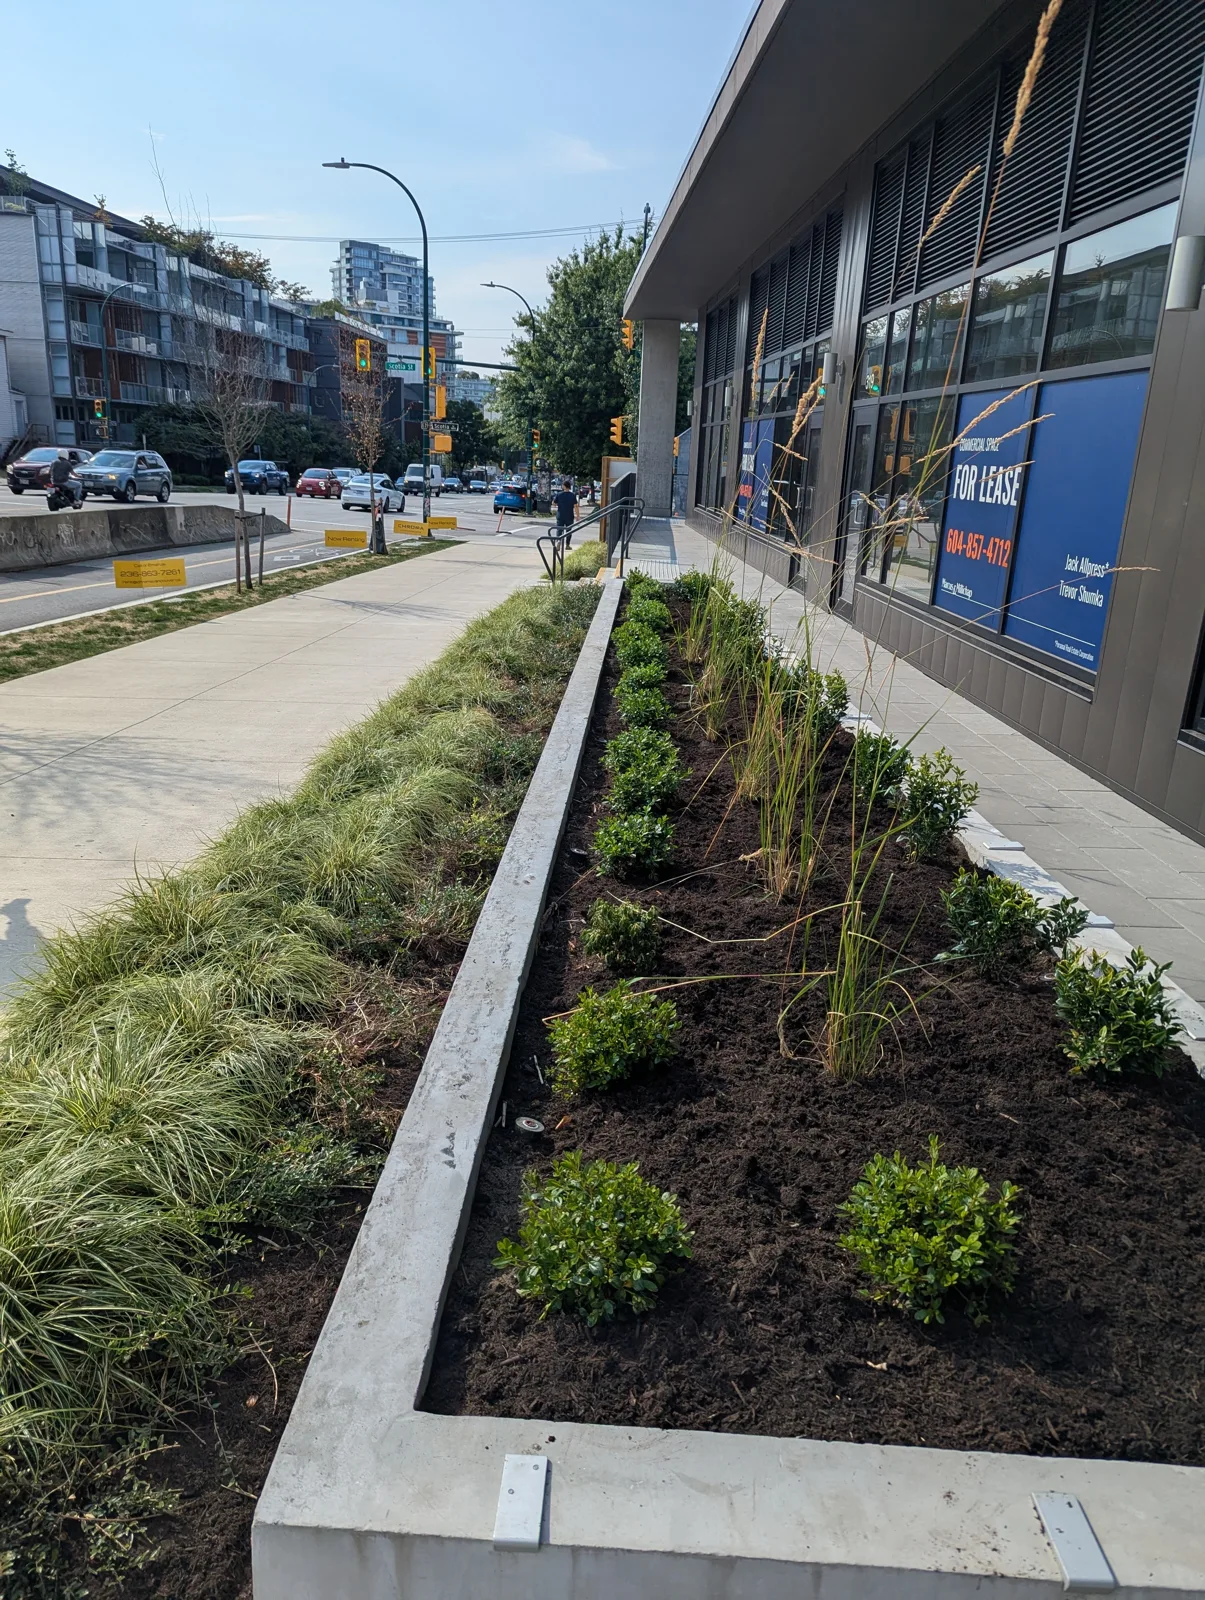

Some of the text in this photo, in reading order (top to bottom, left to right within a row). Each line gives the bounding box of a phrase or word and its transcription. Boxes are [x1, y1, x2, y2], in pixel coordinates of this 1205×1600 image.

[985, 437, 1001, 452] SPACE
[953, 464, 1023, 507] FOR LEASE
[946, 528, 1011, 568] 604-857-4712
[1064, 553, 1079, 572] Jack
[1059, 580, 1104, 607] Trevor Shumka
